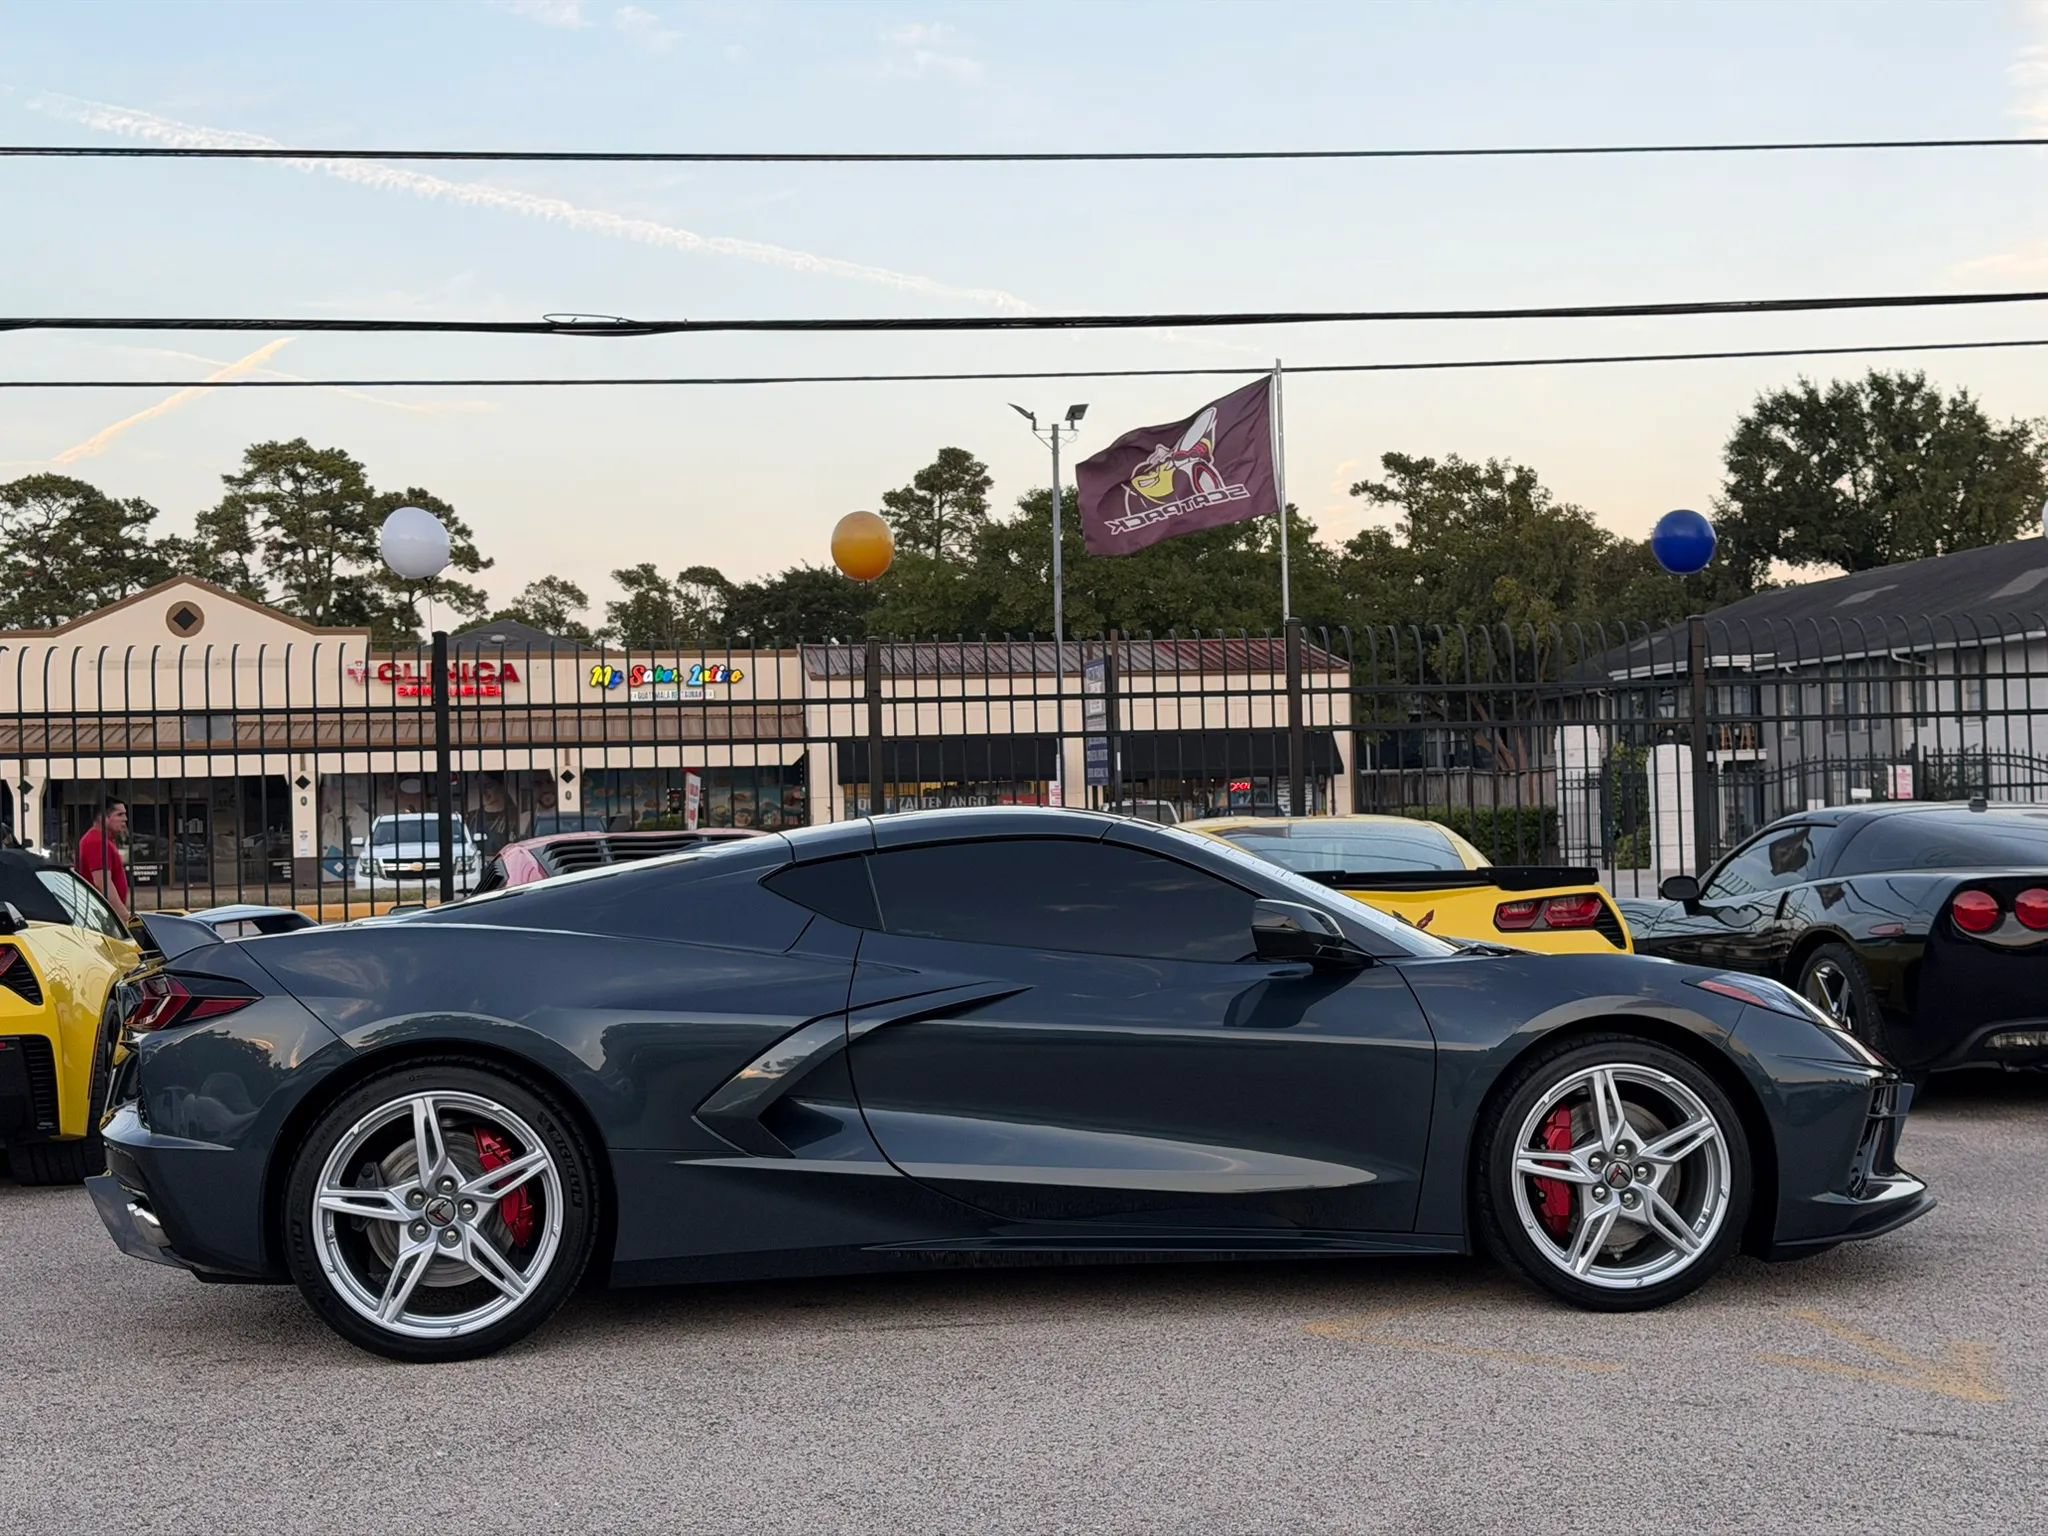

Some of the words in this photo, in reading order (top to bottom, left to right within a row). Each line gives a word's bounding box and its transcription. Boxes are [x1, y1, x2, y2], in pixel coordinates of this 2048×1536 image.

[629, 664, 683, 688] Sabor
[686, 664, 744, 688] Latino
[446, 684, 503, 697] AFAEL
[638, 690, 671, 701] GUATMALA
